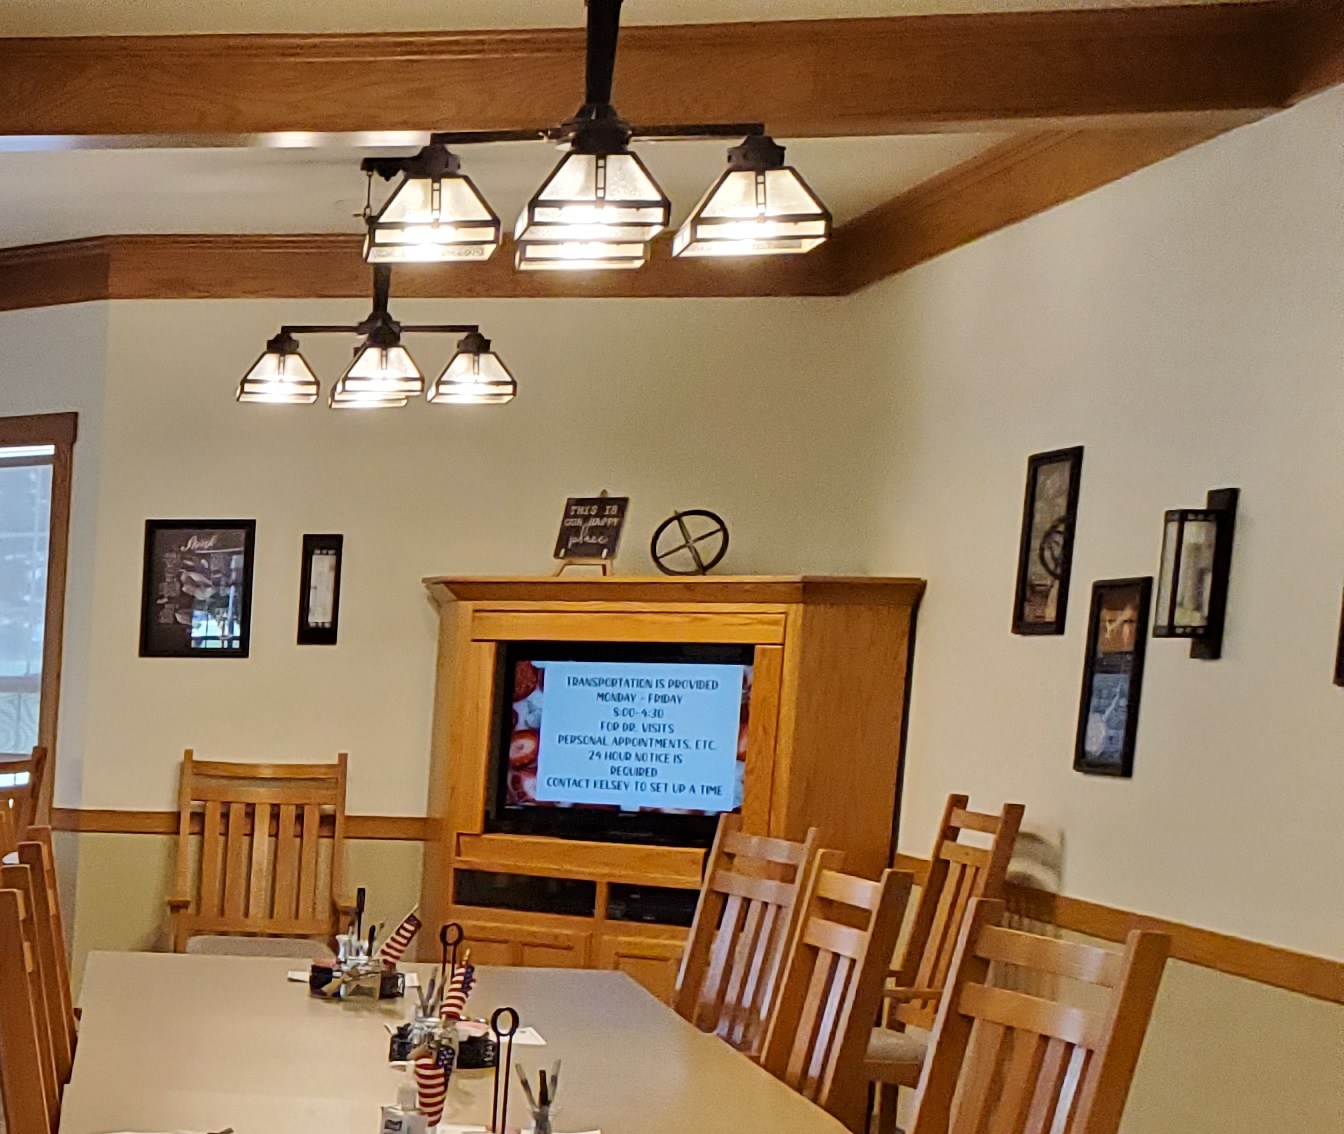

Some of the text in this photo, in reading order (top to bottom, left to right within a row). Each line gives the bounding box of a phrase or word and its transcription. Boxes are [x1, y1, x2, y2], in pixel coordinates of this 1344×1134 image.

[570, 505, 618, 515] THIS IS
[568, 522, 609, 549] place
[567, 676, 719, 690] TRANSPORTATION IS PROVIDED
[596, 692, 637, 703] MONDAY
[648, 693, 683, 705] FRIDAY
[613, 707, 664, 718] 8:00-4:30
[600, 721, 675, 734] FOR DR. VISITS
[557, 735, 608, 746] PERSONAL
[588, 750, 683, 764] 24 HOUR NOTICE IS
[610, 765, 658, 777] REQUIRED
[546, 777, 723, 796] CONTACT KELSEY TO SET UP A TIME
